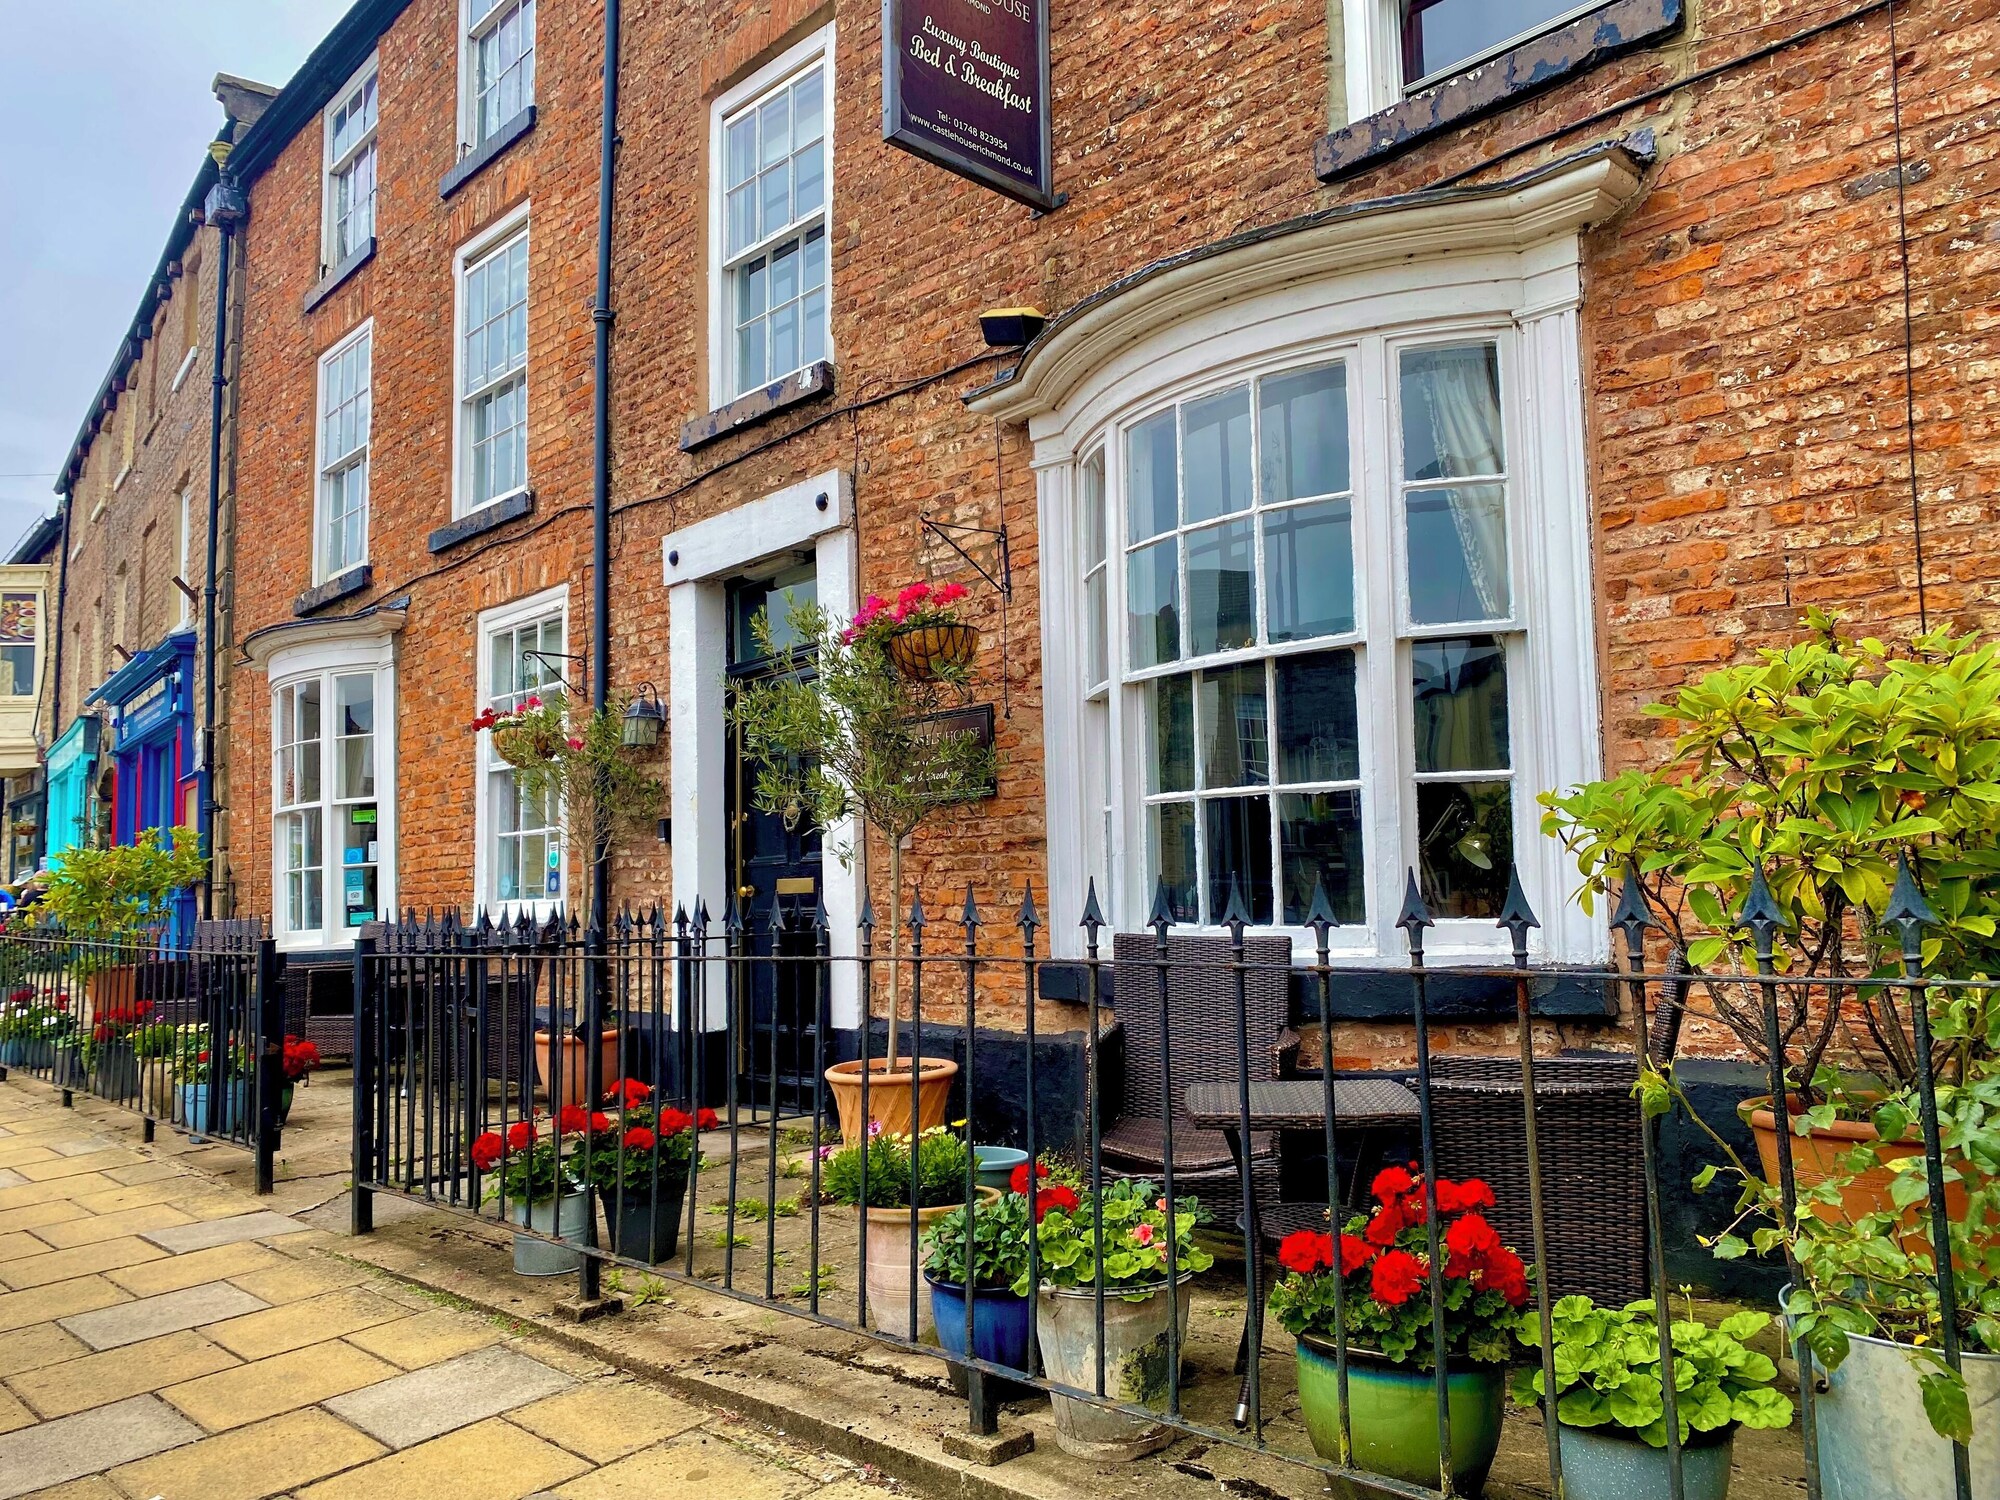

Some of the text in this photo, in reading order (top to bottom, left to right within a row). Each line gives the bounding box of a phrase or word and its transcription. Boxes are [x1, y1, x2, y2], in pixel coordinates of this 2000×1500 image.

[964, 0, 991, 15] MOND
[910, 34, 1032, 114] Bed & Breakfast
[922, 15, 1020, 80] Luxury Boutique
[909, 113, 1033, 176] www.castlehouserichmond.co.uk
[936, 109, 1008, 151] Tel: 01748 823954
